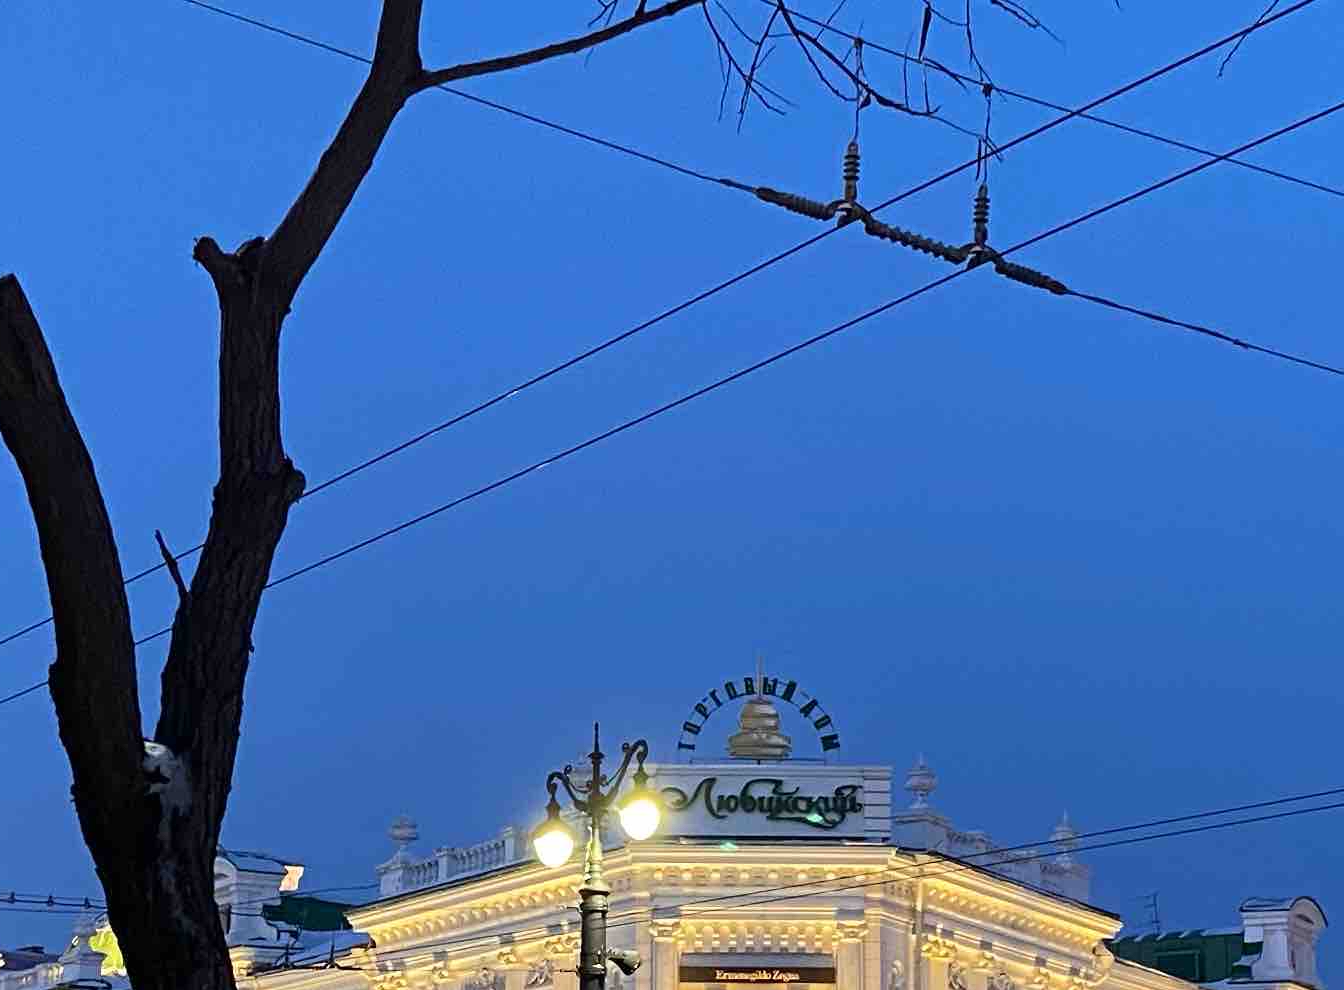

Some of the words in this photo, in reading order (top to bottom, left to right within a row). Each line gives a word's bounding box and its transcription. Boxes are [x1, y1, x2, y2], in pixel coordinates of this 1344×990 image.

[678, 677, 797, 750] ТОРГОВЫЙ
[800, 699, 840, 751] ДОМ
[661, 777, 863, 829] Любинский
